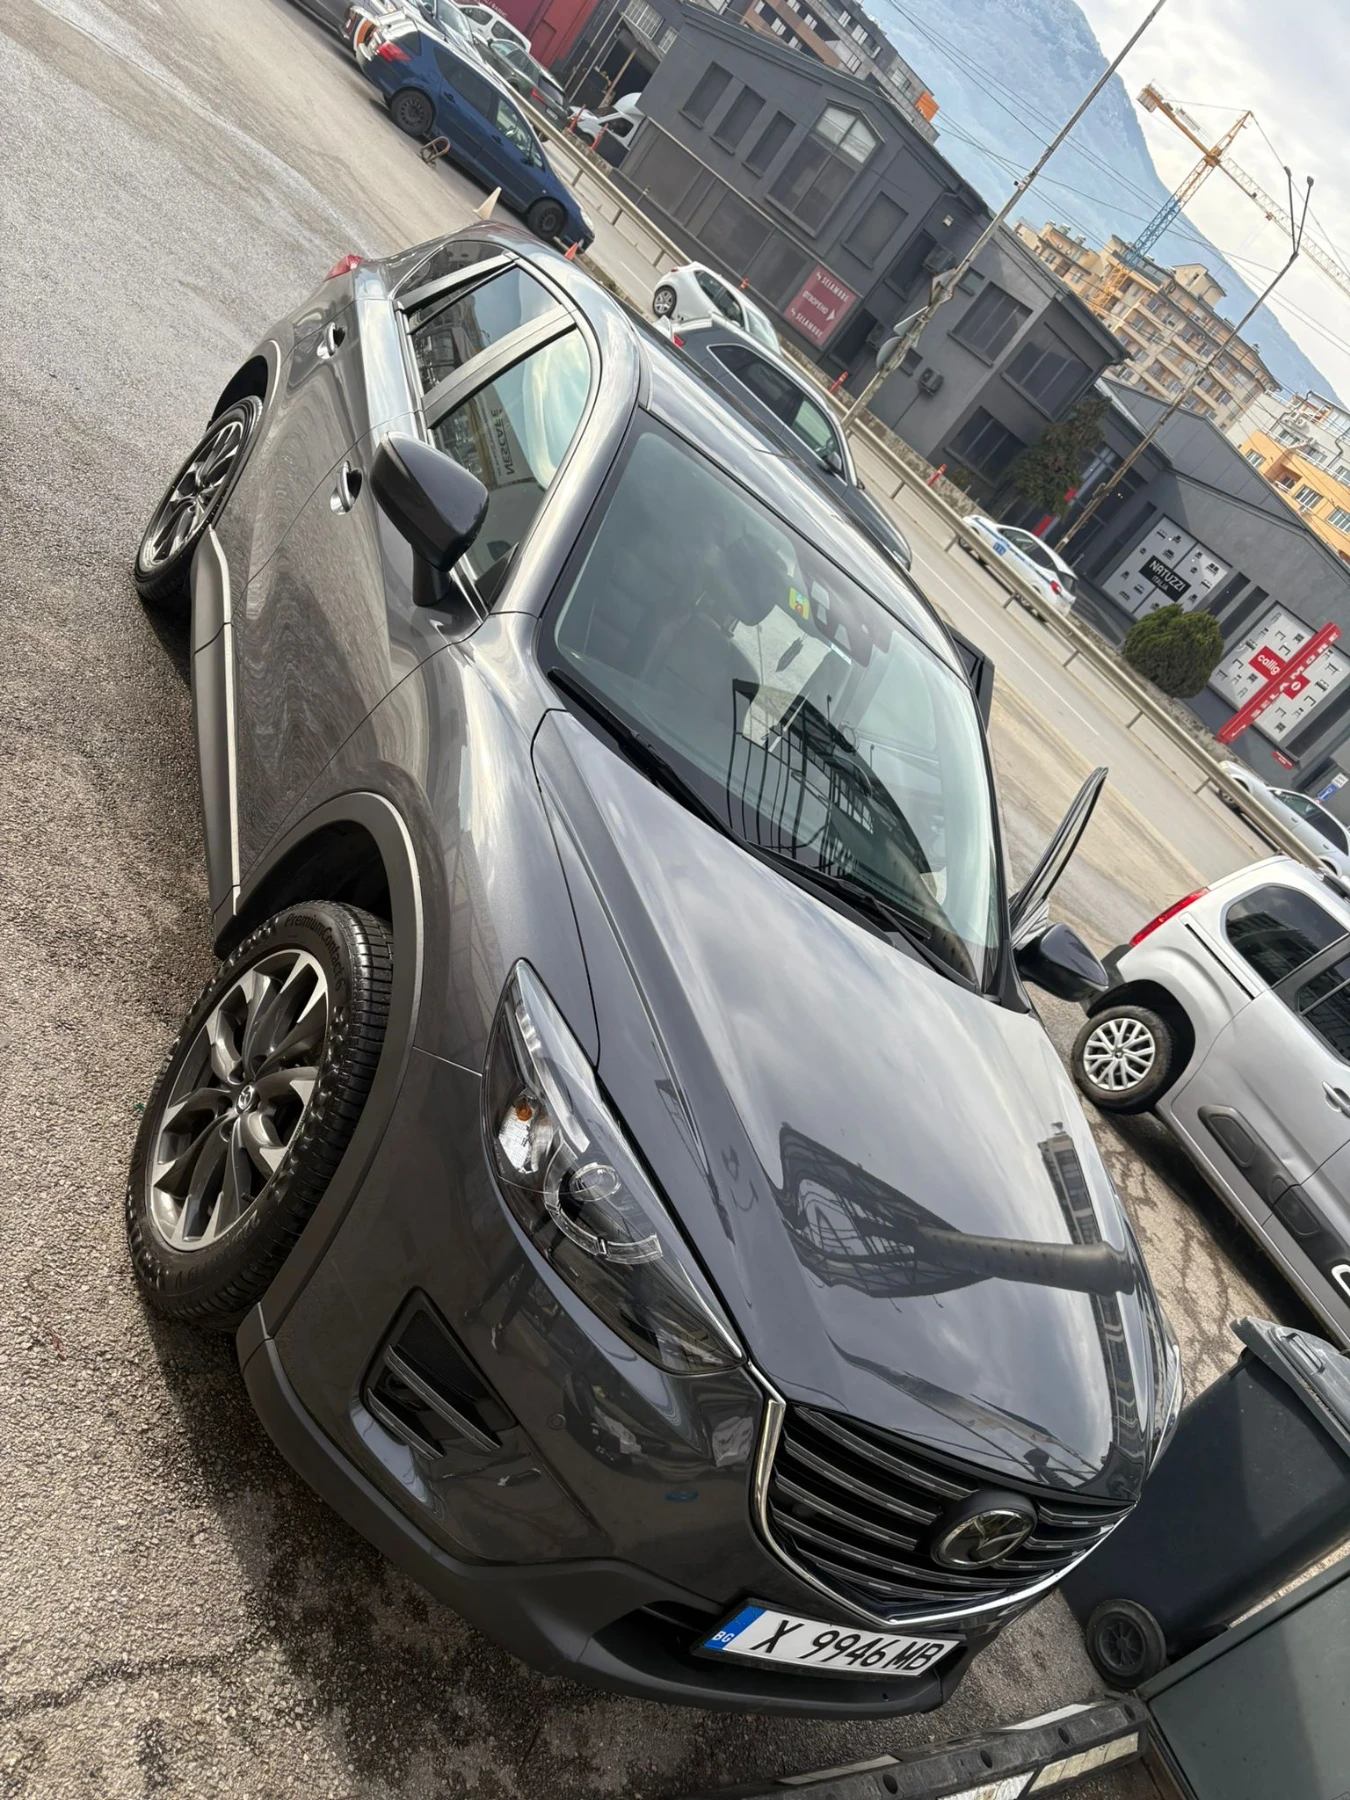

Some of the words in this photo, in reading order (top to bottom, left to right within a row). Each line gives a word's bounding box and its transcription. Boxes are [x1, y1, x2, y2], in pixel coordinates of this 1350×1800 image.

[821, 277, 850, 302] SELAMORE
[795, 312, 823, 338] SELAMORE
[1149, 560, 1186, 591] NATUZZI
[1152, 575, 1169, 591] ITALIA
[1250, 632, 1338, 718] SELAMORE
[1257, 654, 1281, 676] callig
[284, 912, 345, 977] PremiumContact
[335, 980, 346, 992] 6
[711, 1630, 735, 1643] BG
[750, 1619, 804, 1654] X
[799, 1630, 894, 1667] 9946
[881, 1641, 945, 1671] MB
